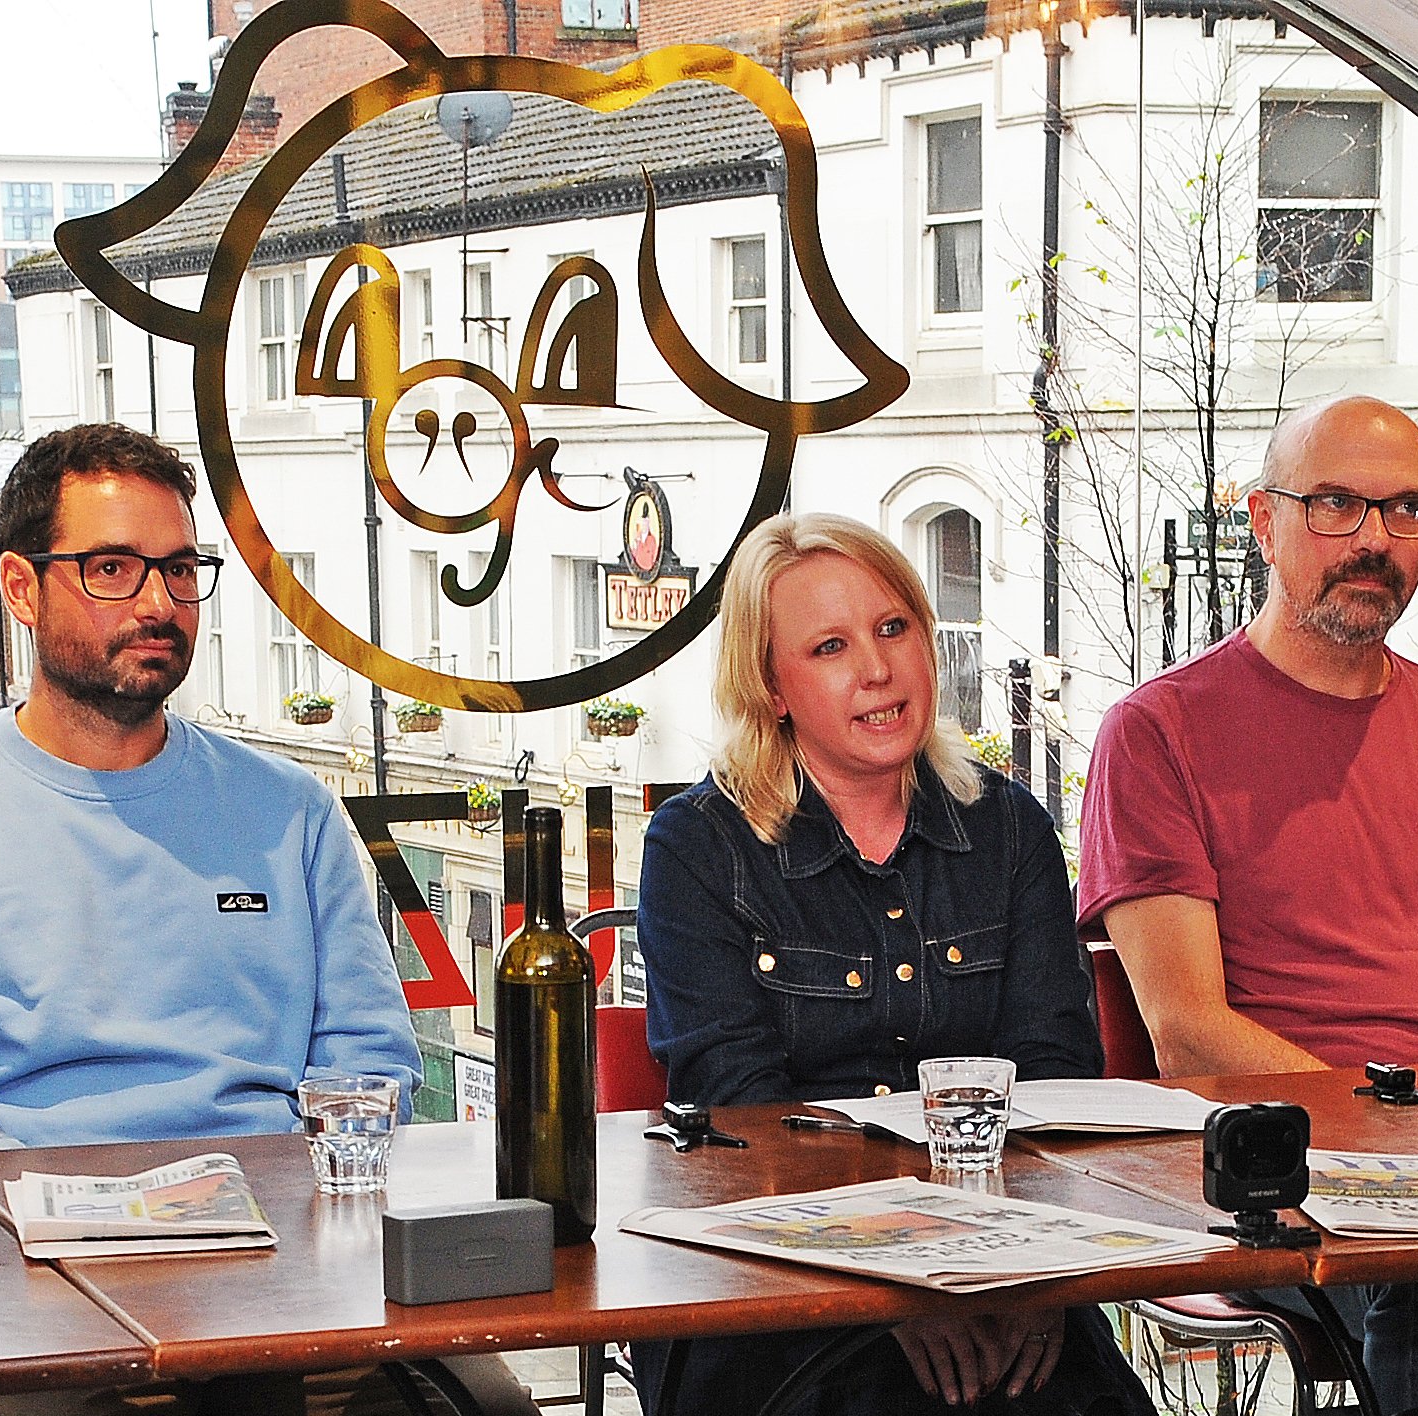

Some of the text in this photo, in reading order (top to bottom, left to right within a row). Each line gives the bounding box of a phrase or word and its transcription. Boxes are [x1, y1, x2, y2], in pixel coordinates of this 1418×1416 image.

[610, 579, 686, 622] TETLEY
[465, 1066, 481, 1083] GREAT
[464, 1083, 480, 1100] GREAT
